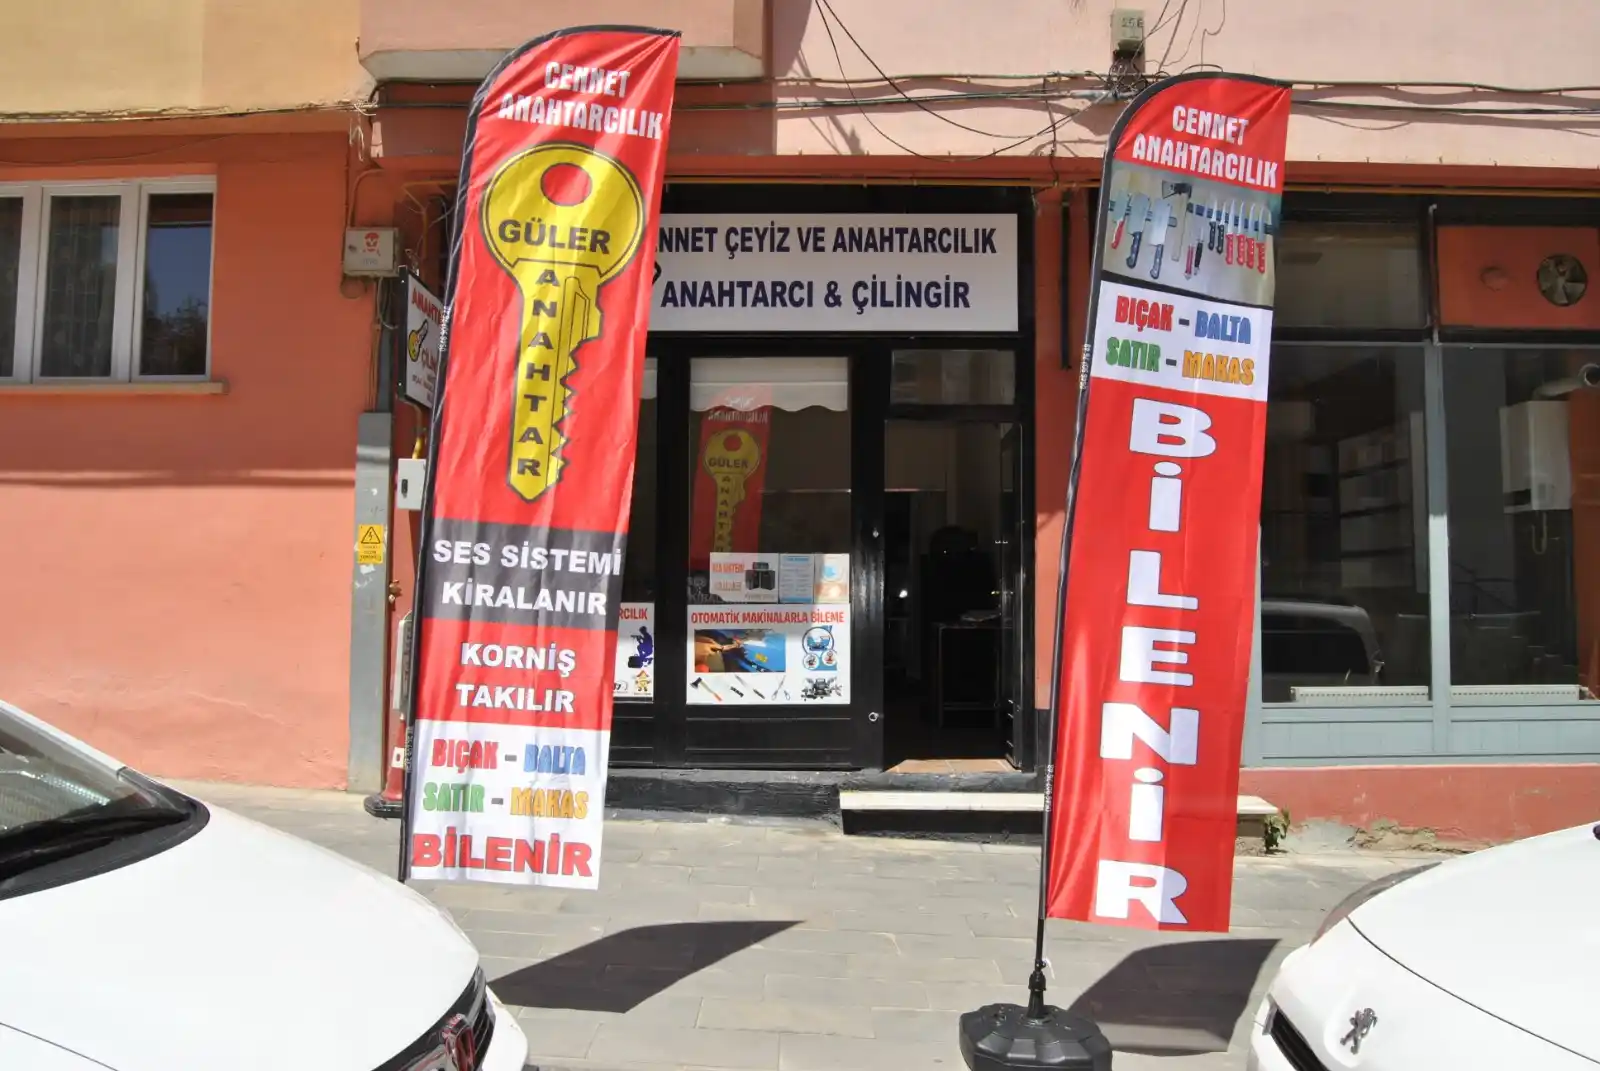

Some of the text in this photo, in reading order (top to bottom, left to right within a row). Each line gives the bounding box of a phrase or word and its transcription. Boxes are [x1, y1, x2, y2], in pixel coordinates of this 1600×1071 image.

[545, 61, 631, 98] CENNET
[499, 93, 663, 139] ANAHTARCILIK
[1172, 105, 1249, 146] CENNET
[1132, 132, 1278, 189] ANAHTARCILIK
[498, 217, 611, 255] GÜLER
[656, 220, 997, 260] NNET ÇEYİZ VE ANAHTARCILIK
[660, 274, 970, 315] ANAHTARCI & ÇİLİNGİR
[1115, 295, 1175, 332] BIÇAK
[1194, 310, 1252, 345] BALTA
[517, 269, 560, 477] ANAHTAR
[1105, 336, 1161, 372] SATIR
[1182, 350, 1255, 386] MAKAS
[433, 539, 622, 576] SES SİSTEMİ
[441, 577, 608, 616] KİRALANIR
[691, 609, 845, 624] OTOMATİK MAKİNALARLA BİLEME
[460, 642, 576, 678] KORNİŞ
[455, 683, 576, 713] TAKILIR
[431, 738, 500, 774] BIÇAK
[523, 743, 586, 776] BALTA
[422, 781, 485, 813] SATIR
[510, 787, 589, 820] MAKAS
[411, 826, 593, 877] BİLENİR
